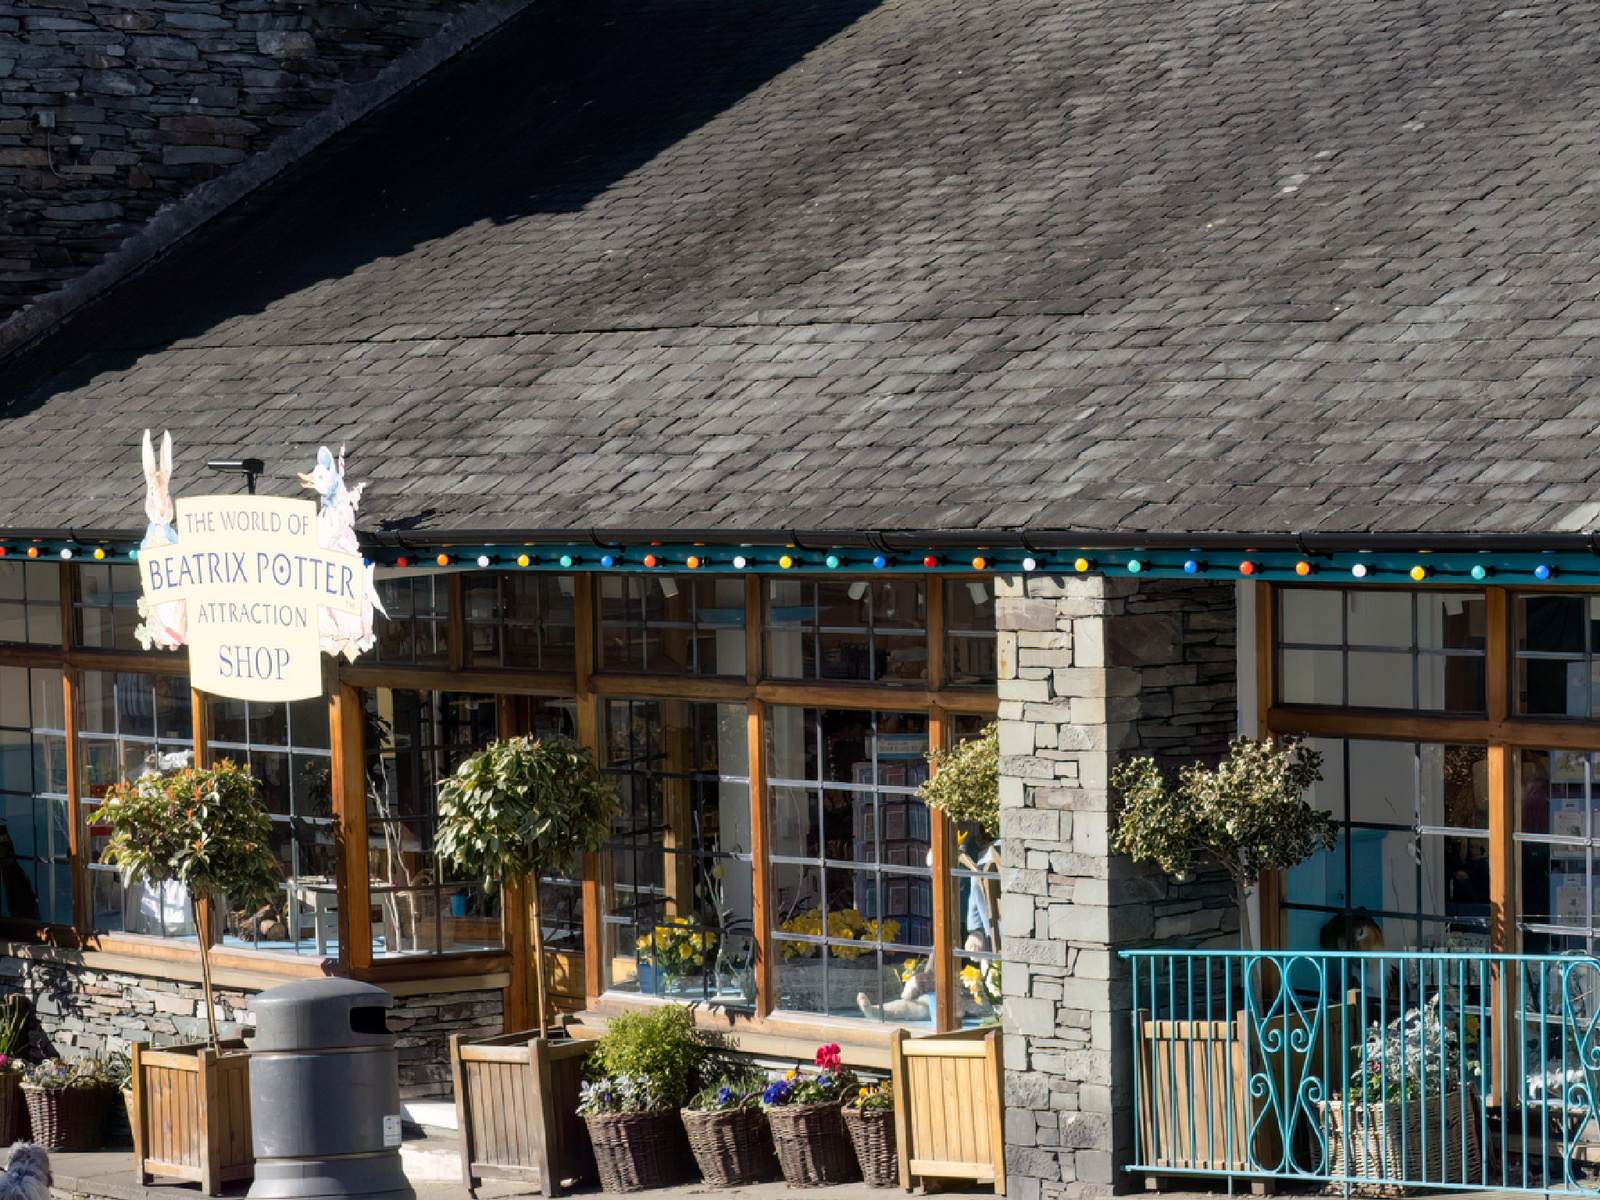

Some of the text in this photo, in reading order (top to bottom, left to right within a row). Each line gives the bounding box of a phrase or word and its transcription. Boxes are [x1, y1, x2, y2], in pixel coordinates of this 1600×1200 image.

[185, 510, 309, 535] THE WORLD OF
[149, 552, 354, 599] BEATRIX POTTER
[198, 602, 307, 627] ATTRACTION
[218, 644, 290, 680] SHOP
